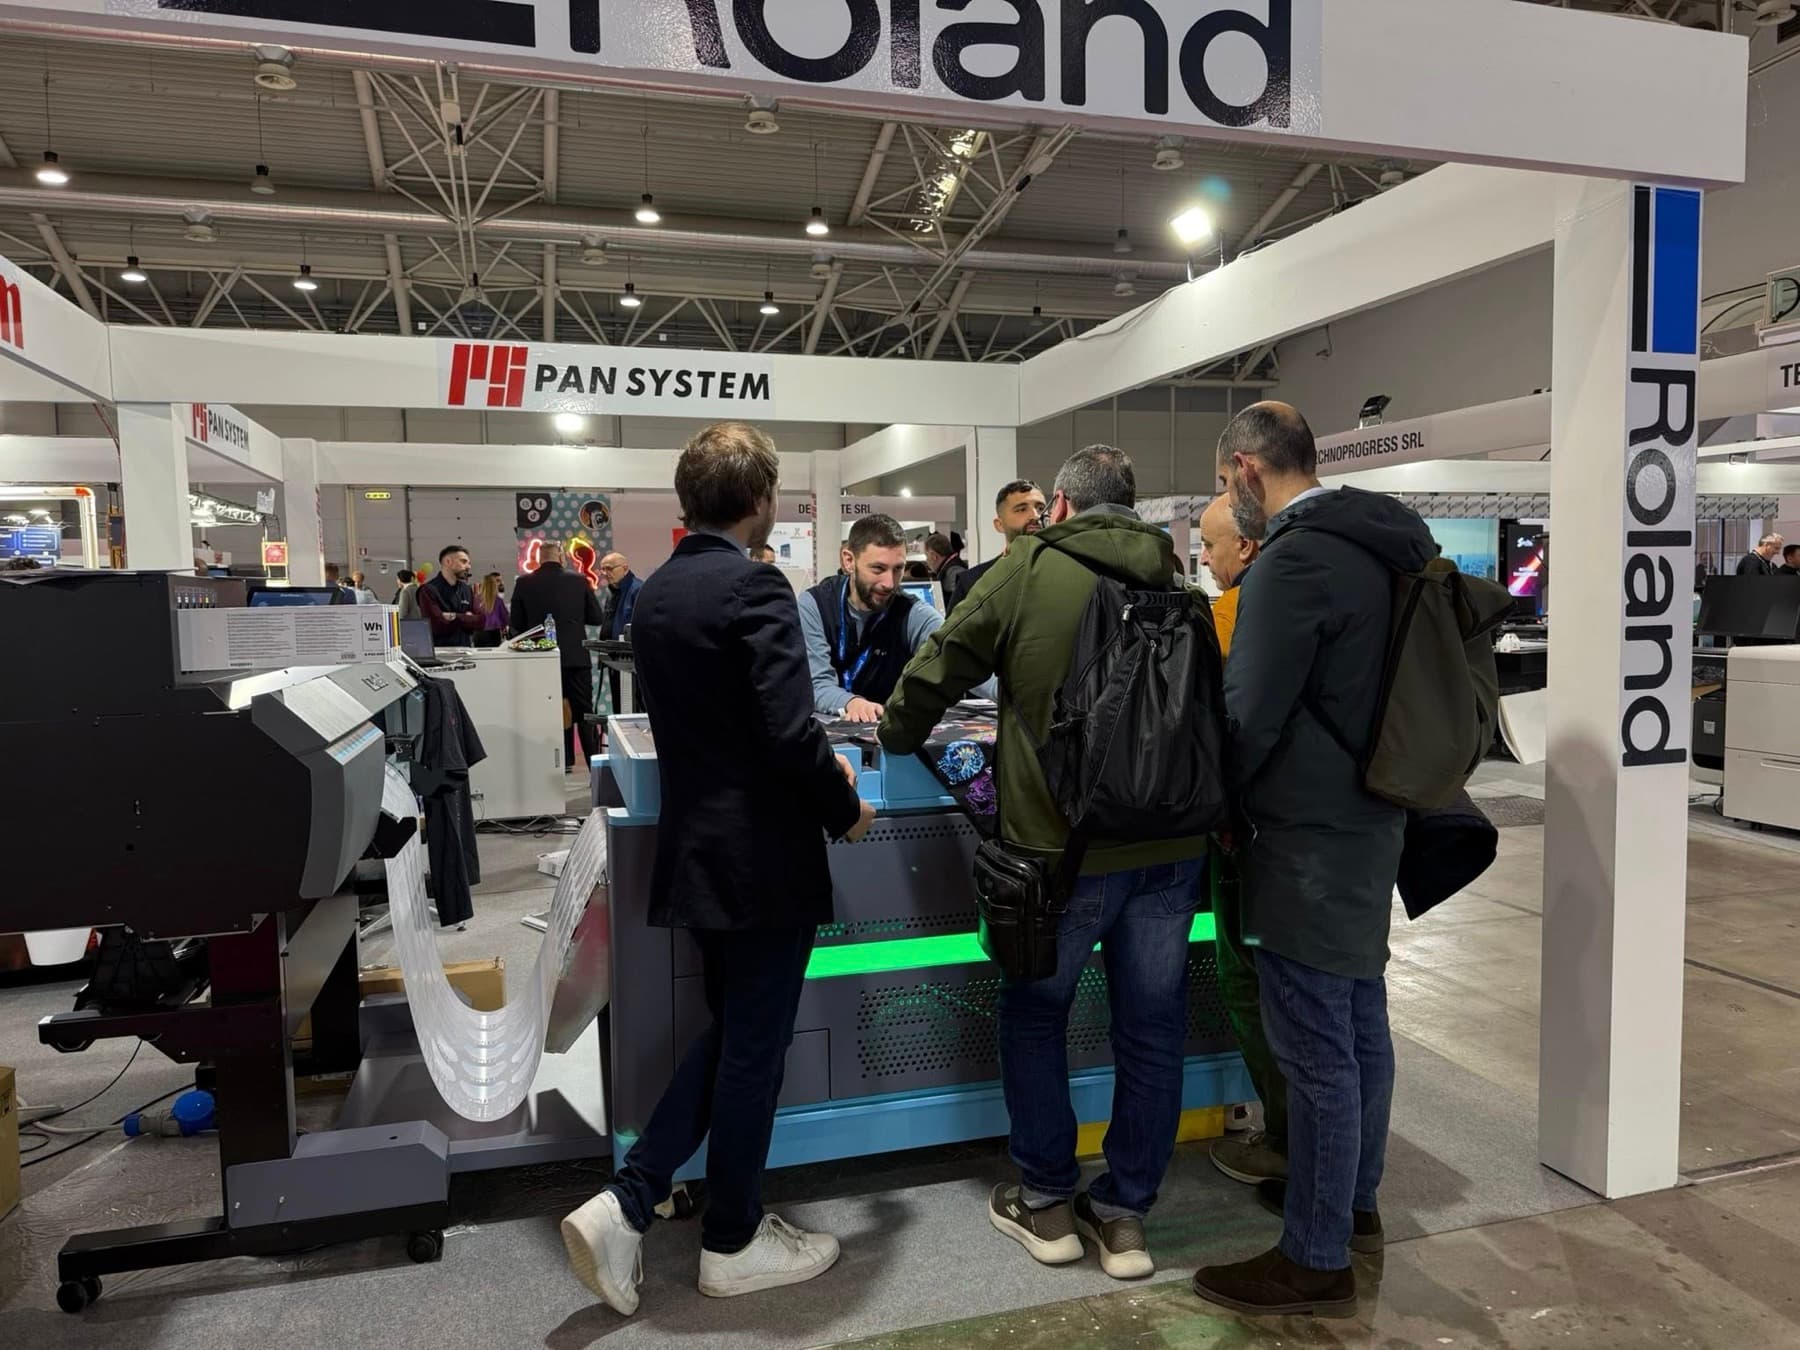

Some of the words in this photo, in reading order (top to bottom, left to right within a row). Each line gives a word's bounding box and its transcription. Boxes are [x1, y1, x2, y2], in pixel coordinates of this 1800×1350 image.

[534, 363, 617, 395] PAN
[626, 367, 770, 401] SYSTEM
[208, 409, 224, 439] PAN
[1401, 432, 1424, 450] SRL
[854, 503, 871, 514] SRL
[1622, 367, 1695, 767] Roland
[364, 622, 382, 631] Wh
